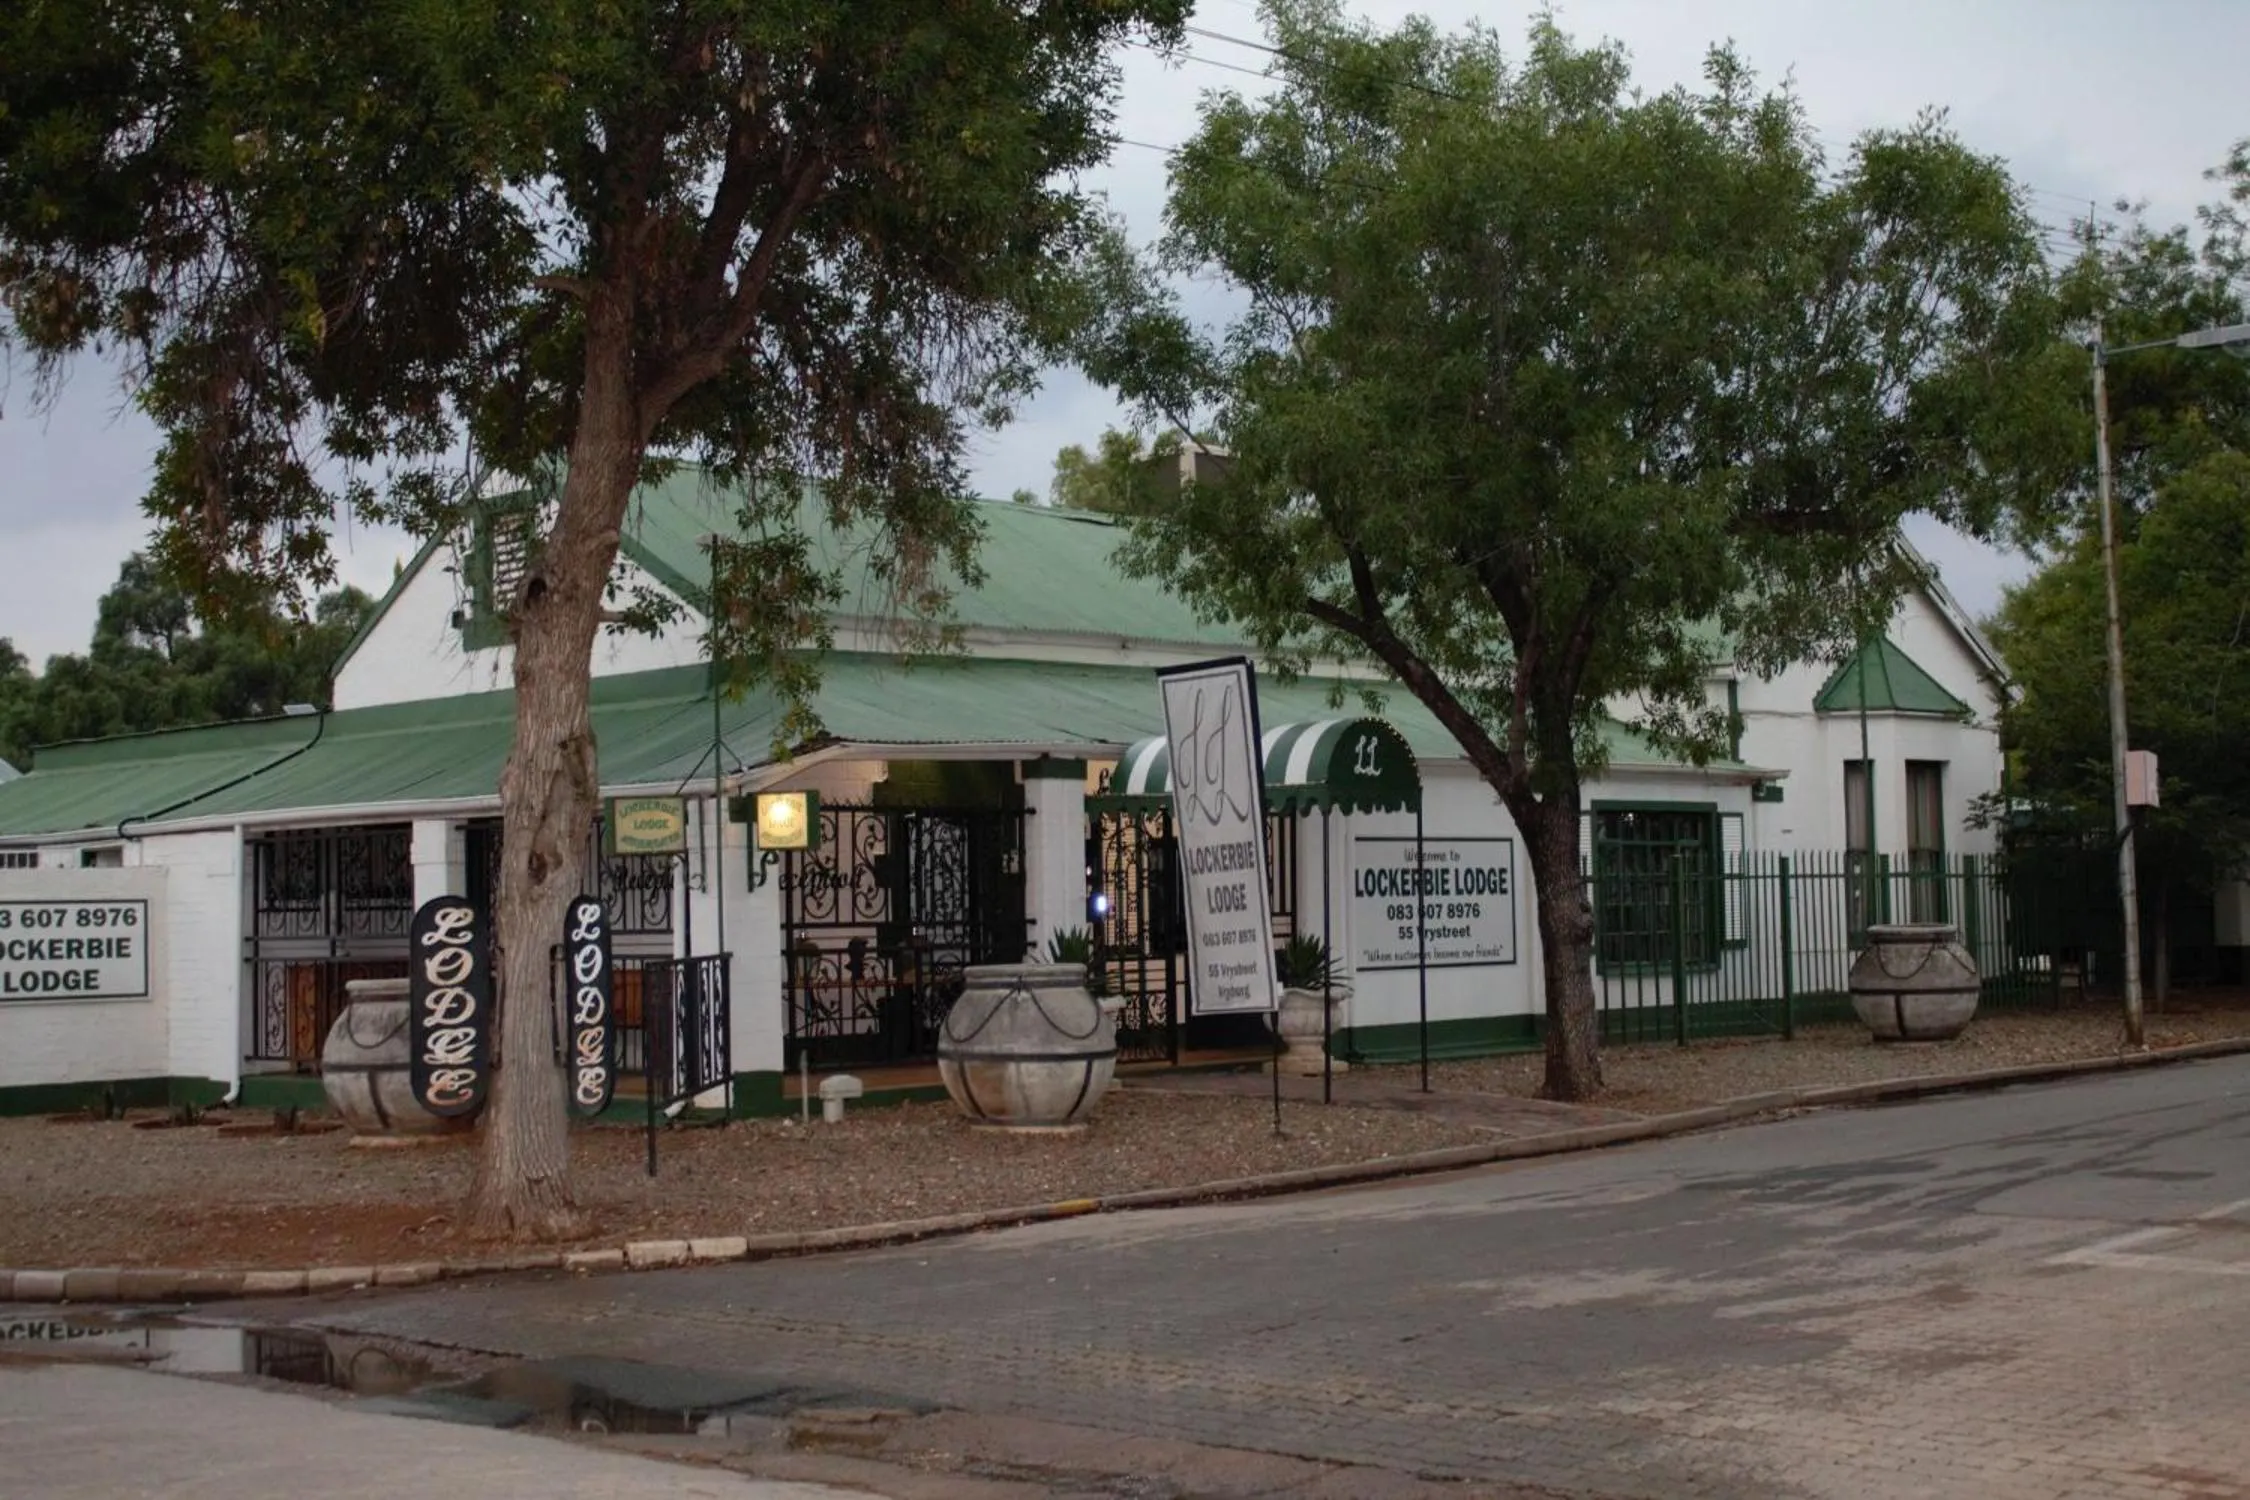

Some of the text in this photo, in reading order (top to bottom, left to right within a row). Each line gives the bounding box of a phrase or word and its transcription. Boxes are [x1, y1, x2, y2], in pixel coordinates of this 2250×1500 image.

[1188, 841, 1255, 874] LOCKERBIE
[1355, 867, 1508, 898] LOCKERBIE LODGE
[1206, 883, 1247, 914] LODGE
[1387, 904, 1414, 920] 083
[1447, 902, 1481, 918] 8976
[20, 909, 68, 928] 607
[76, 908, 138, 927] 8976
[1398, 926, 1414, 940] 55
[0, 937, 132, 961] CKERBIE
[4, 969, 101, 992] LODGE
[421, 907, 477, 1106] LODGE
[571, 903, 606, 1105] LODGE
